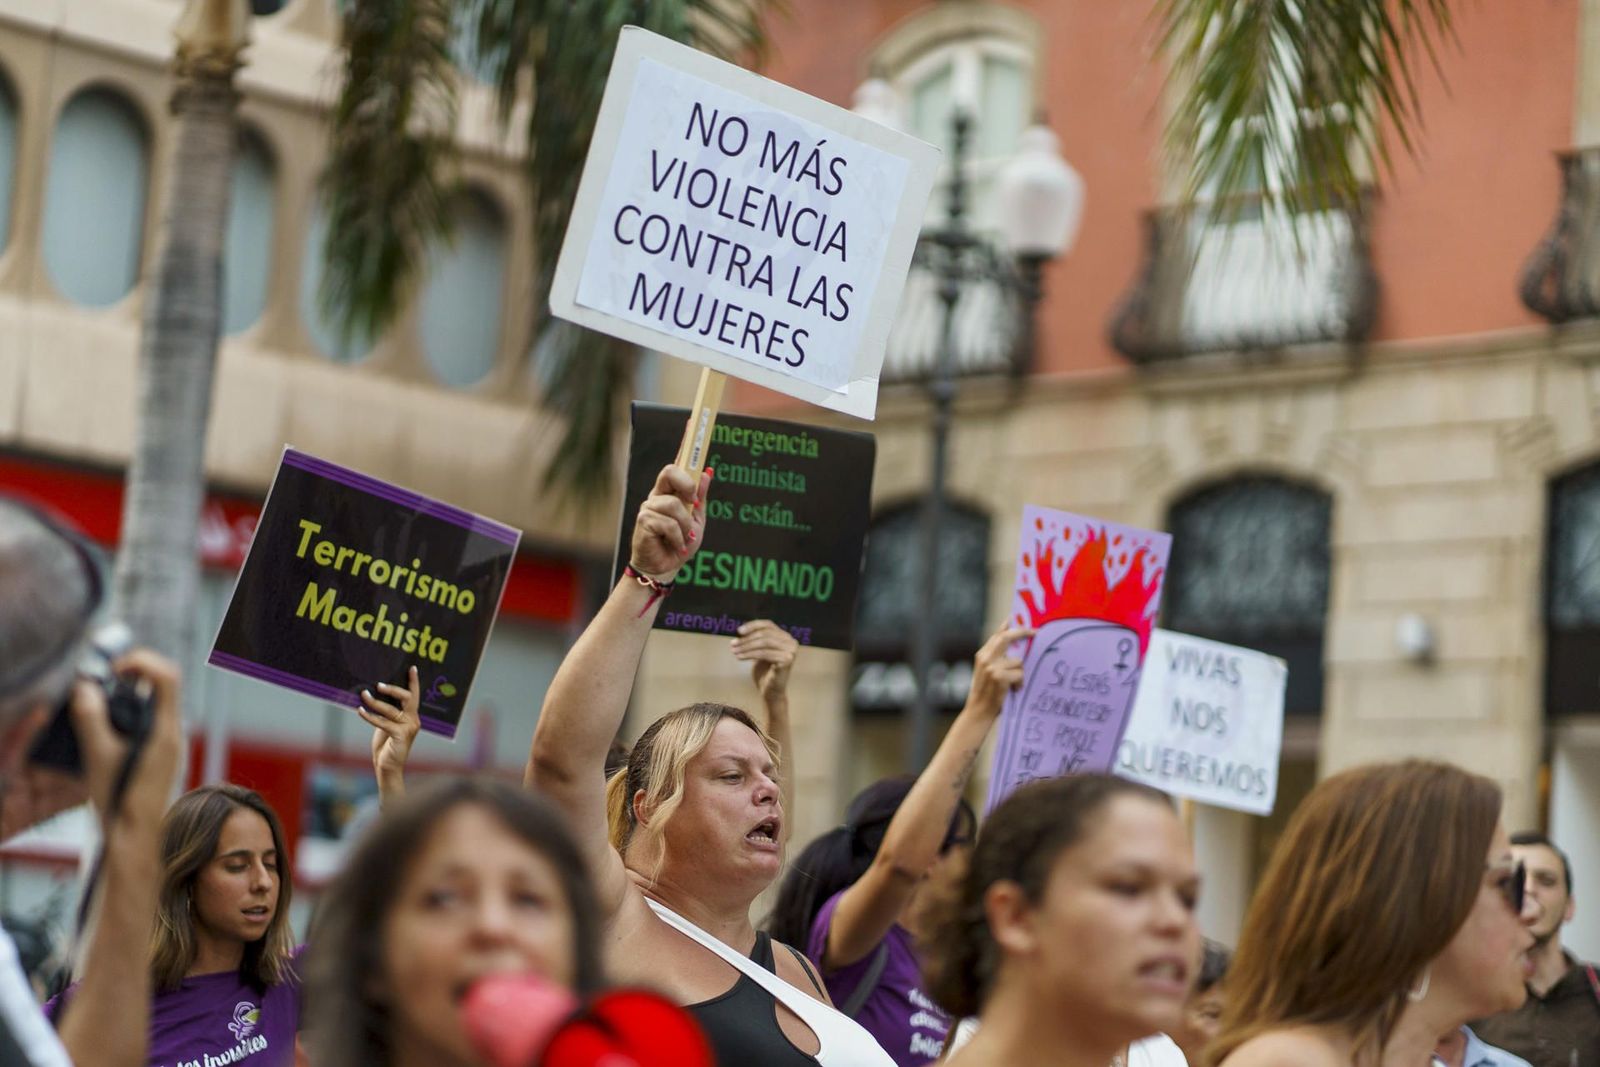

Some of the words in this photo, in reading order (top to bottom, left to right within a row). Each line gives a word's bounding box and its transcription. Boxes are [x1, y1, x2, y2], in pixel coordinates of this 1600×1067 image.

[685, 102, 749, 157] NO
[759, 130, 847, 196] MÁS
[651, 149, 848, 262] VIOLENCIA
[613, 204, 773, 297] CONTRA
[787, 266, 854, 322] LAS
[628, 272, 809, 367] MUJERES
[711, 424, 819, 458] mergencia
[709, 454, 806, 493] feminista
[706, 500, 734, 520] os
[295, 519, 476, 614] Terrorismo
[674, 551, 834, 601] SESINANDO
[295, 582, 449, 663] Machista
[1165, 644, 1242, 687] VIVAS
[1172, 698, 1229, 736] NOS
[1119, 739, 1269, 798] QUEREMOS
